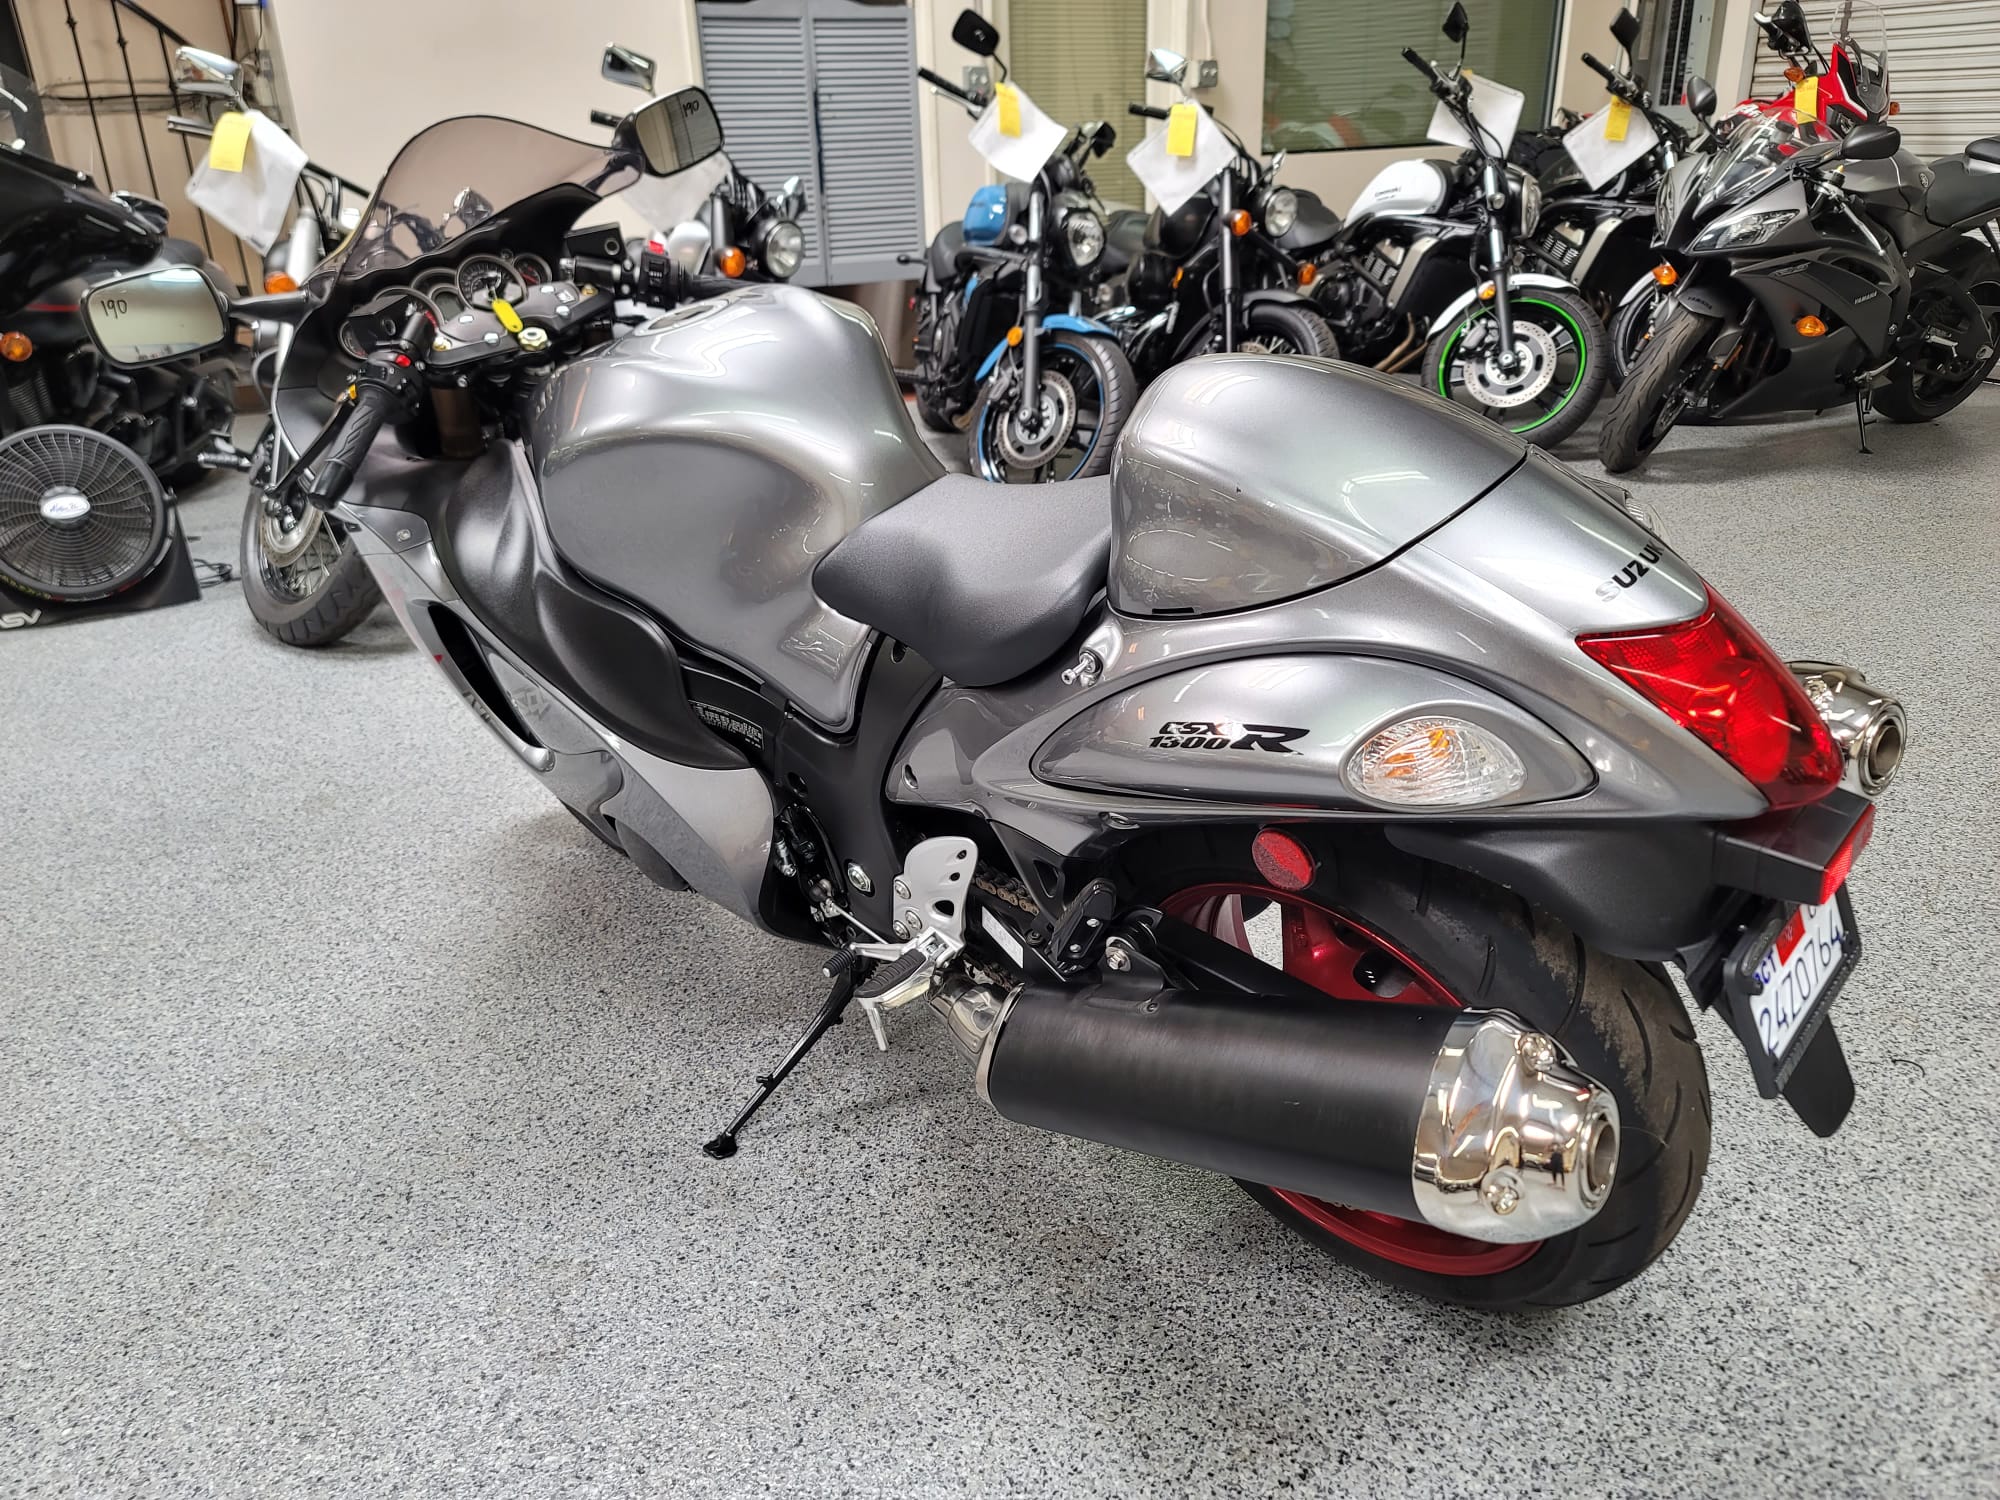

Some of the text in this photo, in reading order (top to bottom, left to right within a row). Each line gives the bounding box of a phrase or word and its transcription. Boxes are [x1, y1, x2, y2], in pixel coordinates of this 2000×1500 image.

[682, 100, 700, 118] 190
[100, 299, 128, 319] 190
[1149, 735, 1231, 750] 1300
[1759, 908, 1843, 1056] 24Z0764
